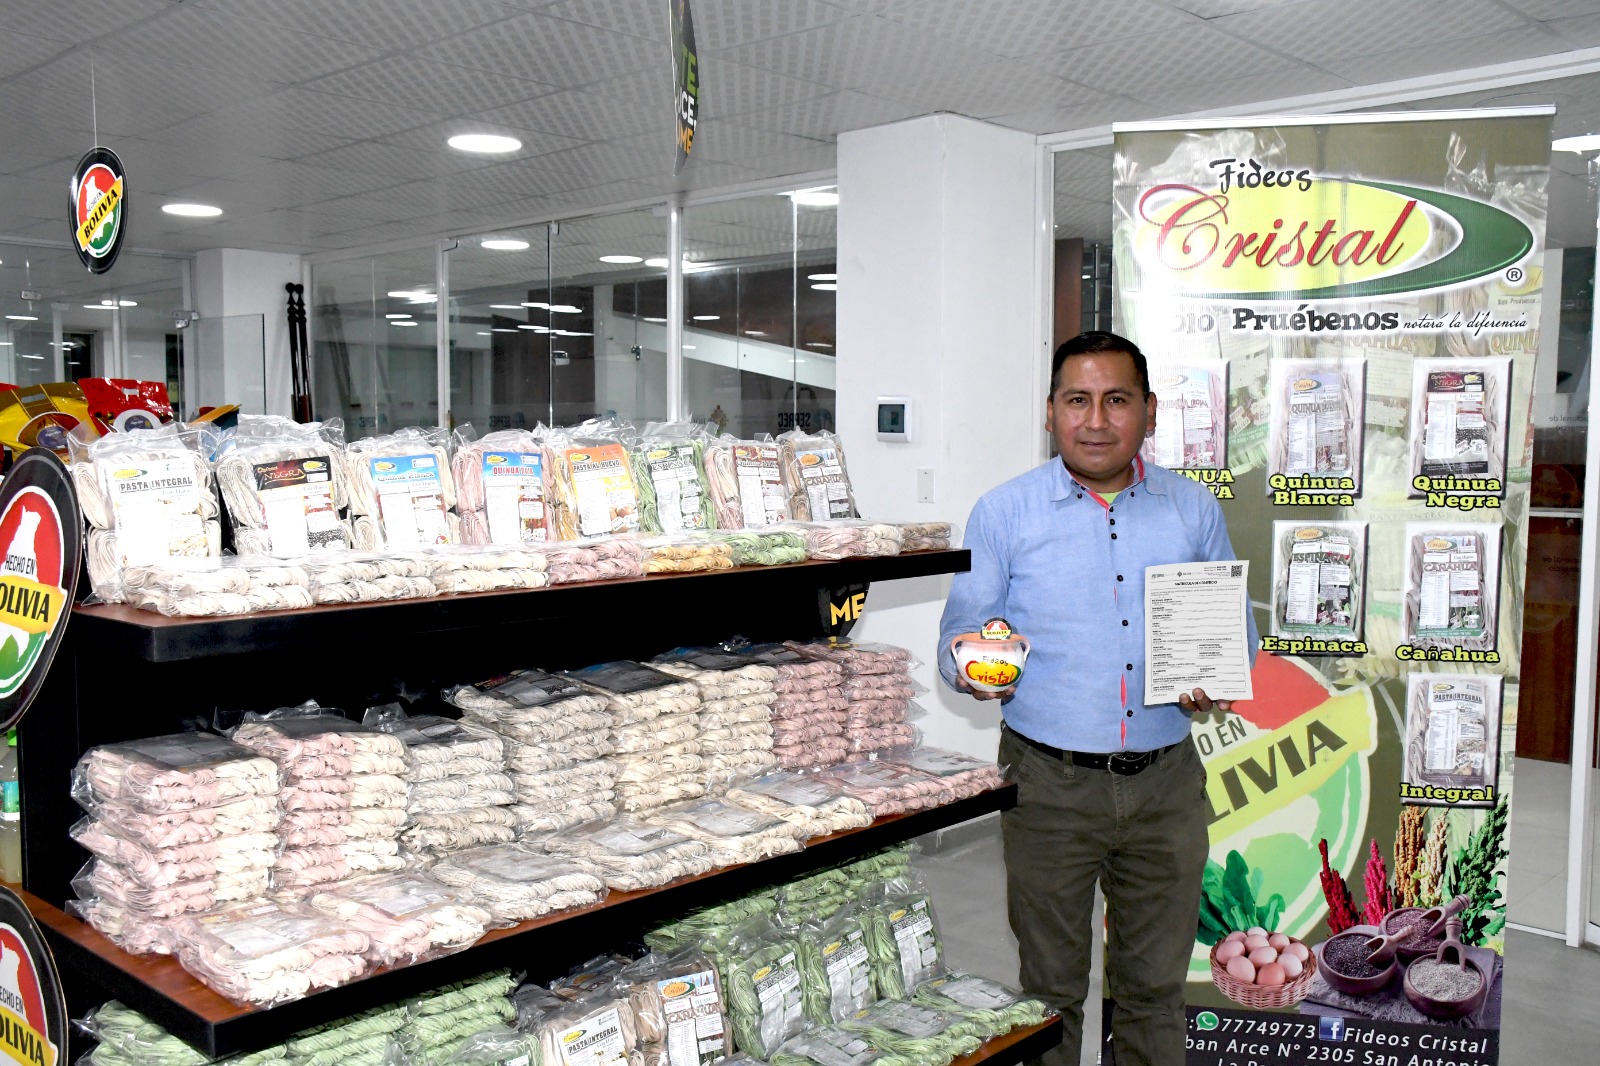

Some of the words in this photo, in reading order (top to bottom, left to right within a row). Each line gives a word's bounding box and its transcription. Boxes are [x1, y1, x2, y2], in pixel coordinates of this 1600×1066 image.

[1210, 158, 1312, 193] Fideos
[84, 189, 117, 239] BOLIVIA
[1138, 183, 1418, 271] Cristal
[1232, 304, 1398, 334] Pruébenos
[1403, 312, 1445, 329] notará
[1448, 311, 1463, 328] la
[1466, 311, 1528, 337] diferencia
[264, 468, 305, 481] NEGRA
[492, 466, 519, 475] QUINUA
[573, 463, 590, 472] PASTA
[601, 459, 620, 468] HUEVO
[120, 481, 149, 492] PASTA
[151, 477, 193, 490] INTEGRAL
[1268, 473, 1355, 491] Quinua
[1412, 474, 1502, 492] Quinua
[1272, 490, 1355, 506] Blanca
[1426, 491, 1501, 512] Negra
[5, 554, 26, 573] HECHO
[25, 557, 35, 575] EN
[0, 583, 50, 623] OLIVIA
[1262, 635, 1369, 655] Espinaca
[1395, 644, 1500, 663] Cañahua
[965, 660, 1015, 685] Cristal
[1434, 693, 1453, 702] PASTA
[1454, 692, 1482, 704] INTEGRAL
[1206, 719, 1348, 827] LIVIA
[1400, 782, 1495, 803] Integral
[0, 986, 14, 1008] ECHO
[568, 1040, 590, 1054] PASTA
[589, 1025, 618, 1045] INTEGRAL
[1221, 1018, 1316, 1040] 77749773
[1343, 1027, 1411, 1048] Fideos
[1419, 1034, 1488, 1054] Cristal
[1185, 1035, 1219, 1052] ban
[1226, 1039, 1270, 1057] Arce
[1306, 1046, 1356, 1063] 2305
[1363, 1050, 1398, 1066] San
